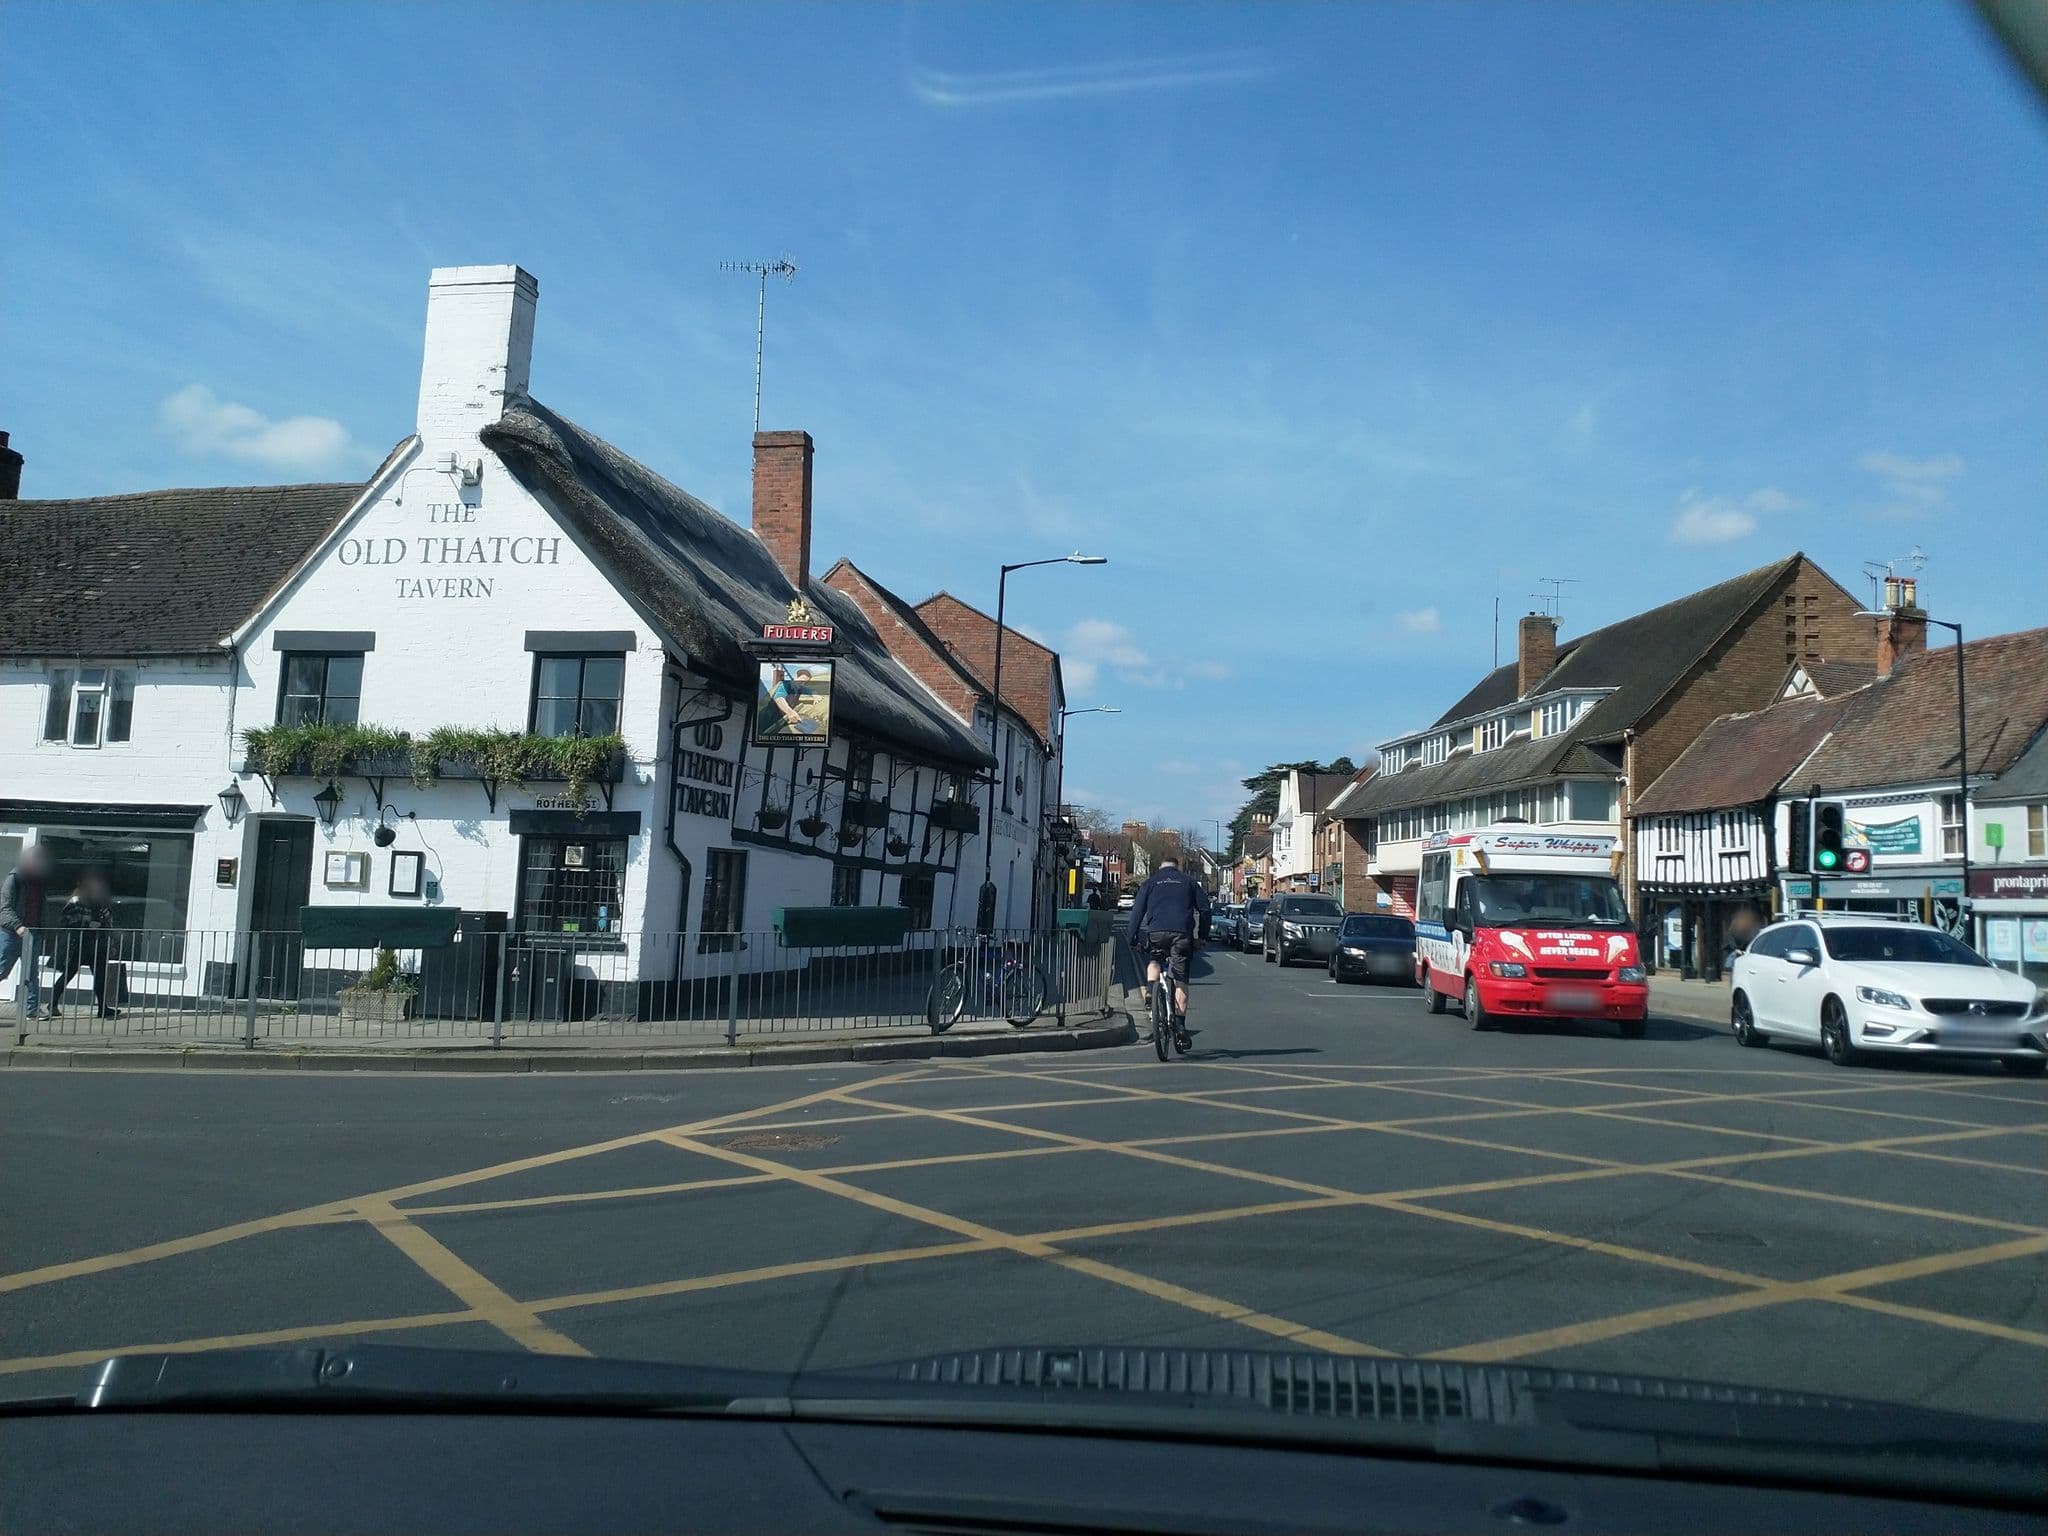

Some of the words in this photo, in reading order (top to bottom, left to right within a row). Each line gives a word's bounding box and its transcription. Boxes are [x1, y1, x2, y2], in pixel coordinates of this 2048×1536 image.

[427, 503, 476, 523] THE
[338, 538, 407, 566] OLD
[417, 537, 562, 565] THATCH
[395, 578, 495, 598] TAVERN
[694, 720, 723, 752] OLD
[678, 747, 735, 788] THATCH
[677, 783, 732, 820] TAVERN
[1494, 837, 1540, 850] Super
[1544, 838, 1600, 853] Whippy
[1993, 874, 2048, 893] prontapri
[1540, 946, 1568, 955] NEVER
